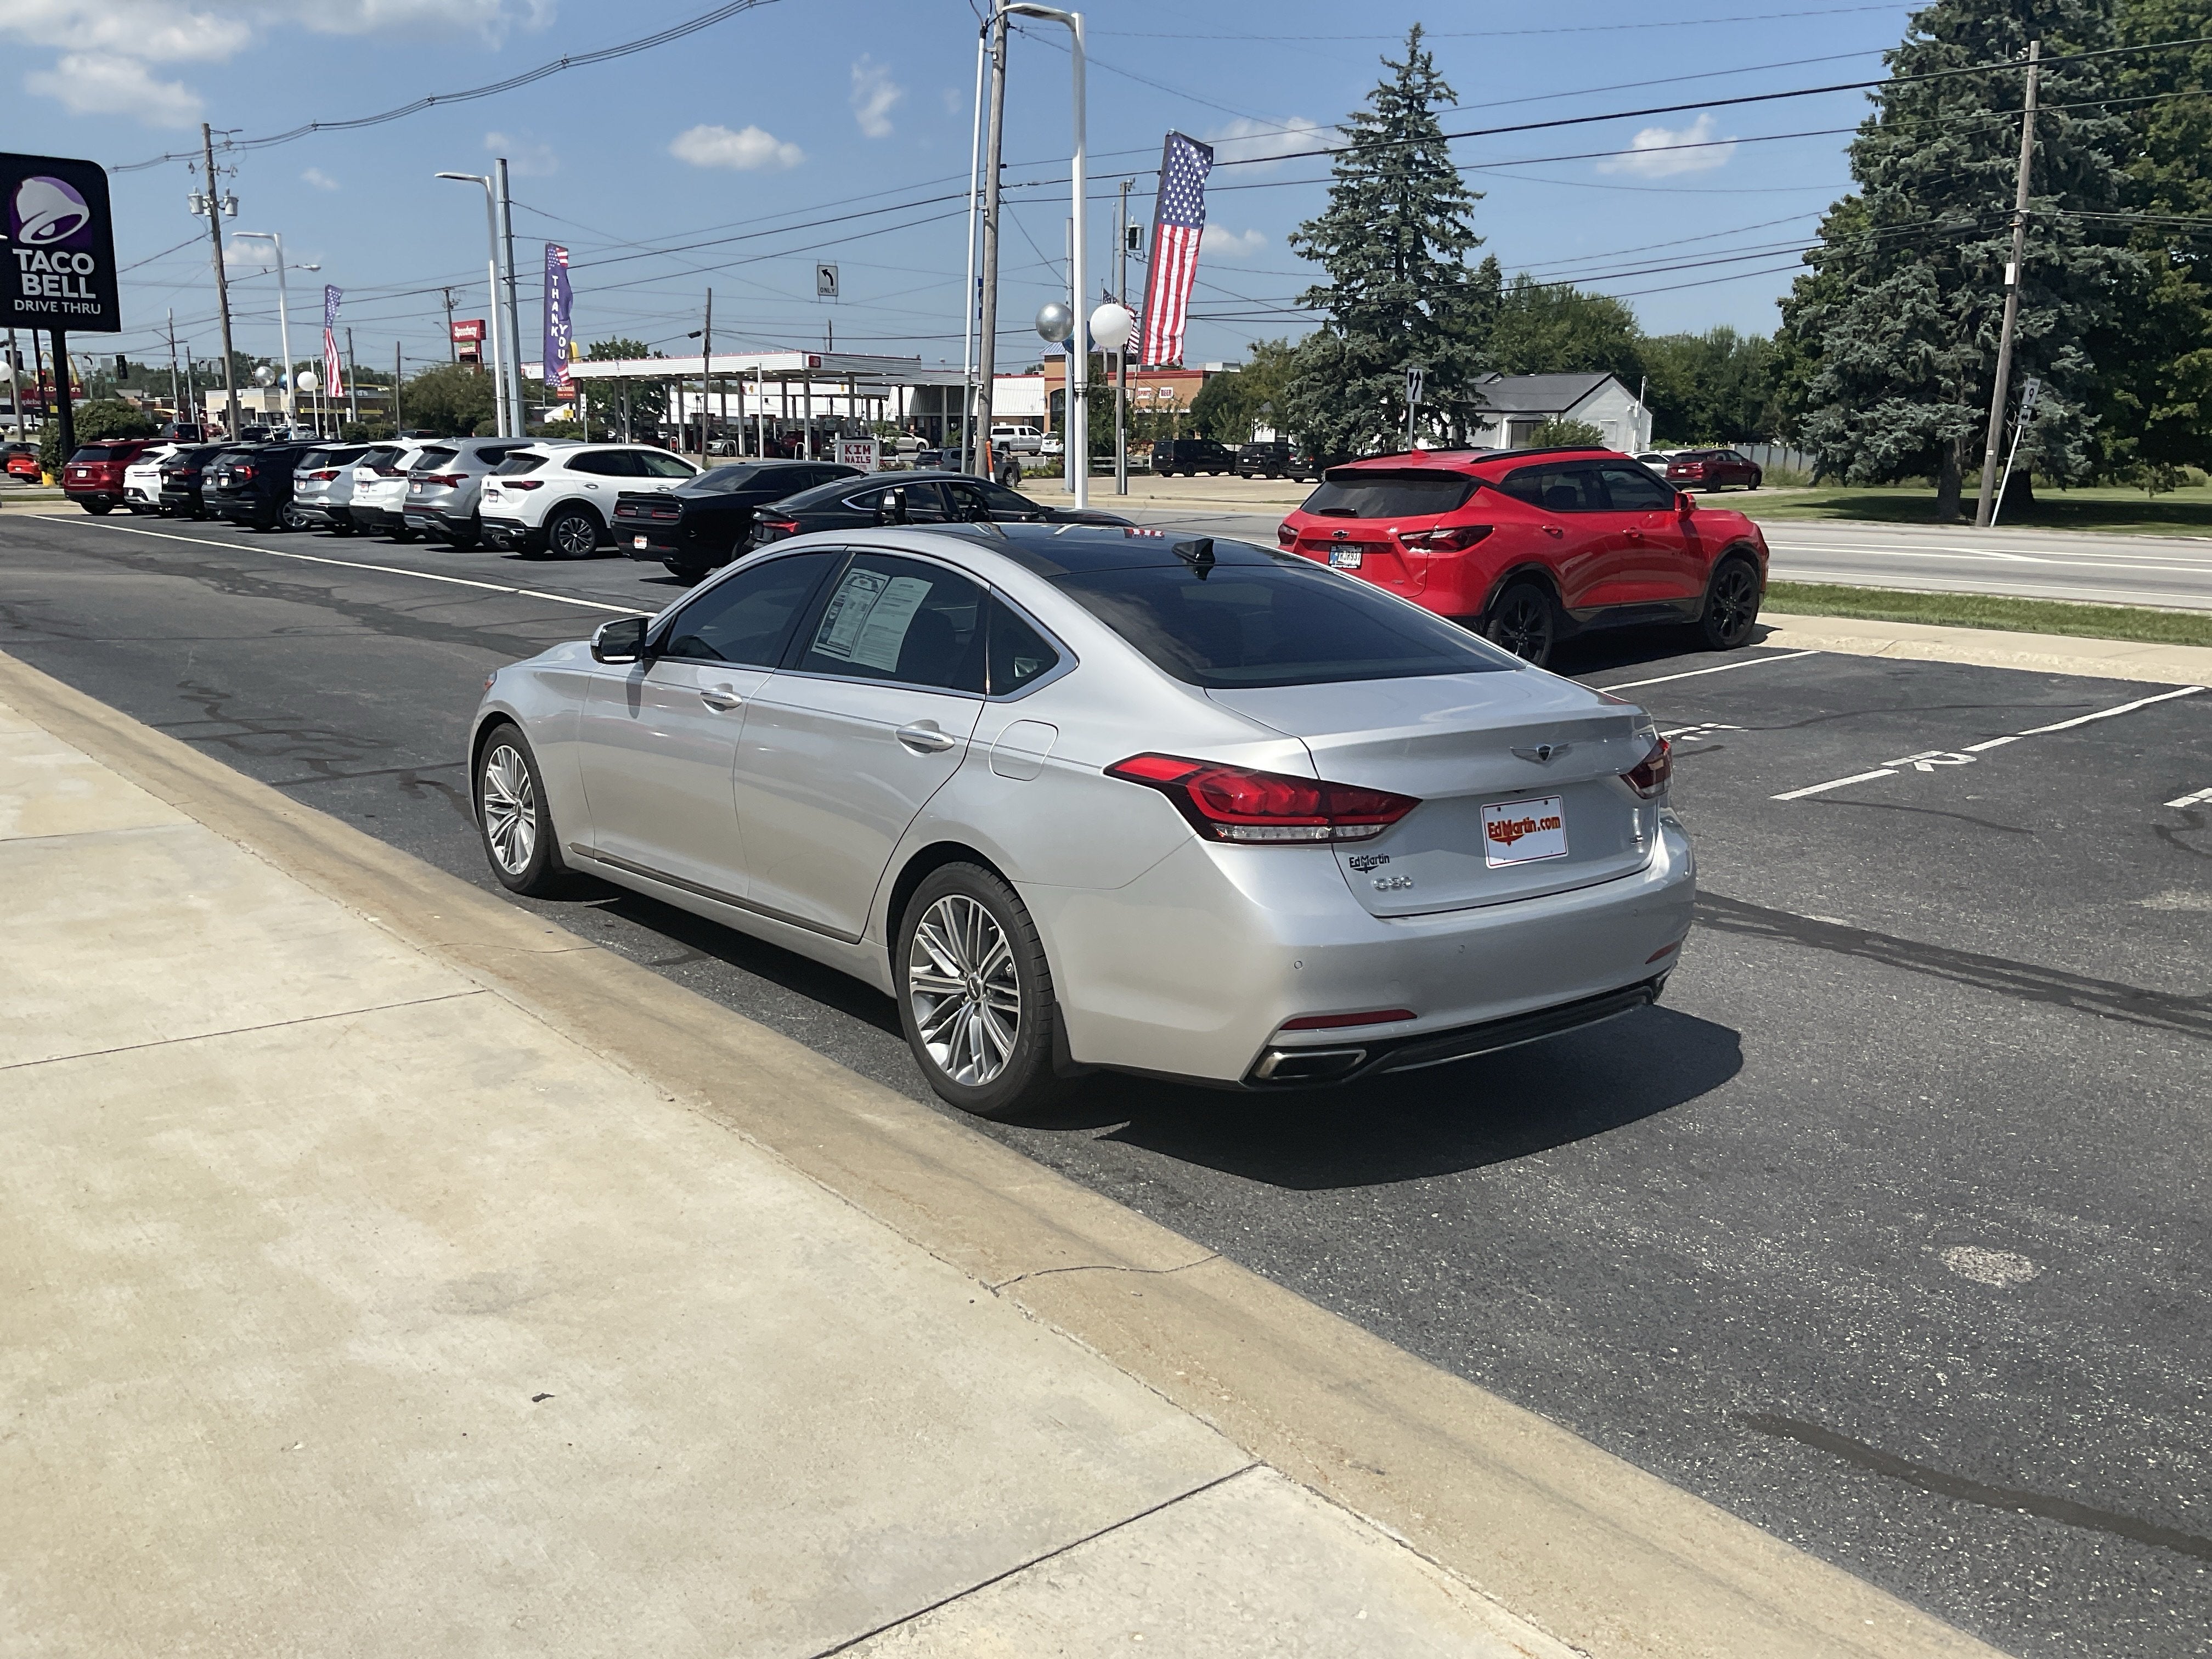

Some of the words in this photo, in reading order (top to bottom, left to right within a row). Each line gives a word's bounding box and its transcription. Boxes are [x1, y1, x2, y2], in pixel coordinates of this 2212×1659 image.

[12, 249, 94, 275] TACO
[21, 273, 96, 298] BELL
[14, 300, 59, 312] DRIVE
[61, 302, 101, 314] THRU
[551, 275, 560, 337] THANK
[557, 324, 568, 360] YOU
[2028, 387, 2034, 403] 9
[845, 444, 871, 455] KIM
[1487, 816, 1561, 838] EdMartin.com
[1349, 854, 1390, 868] EdMartin
